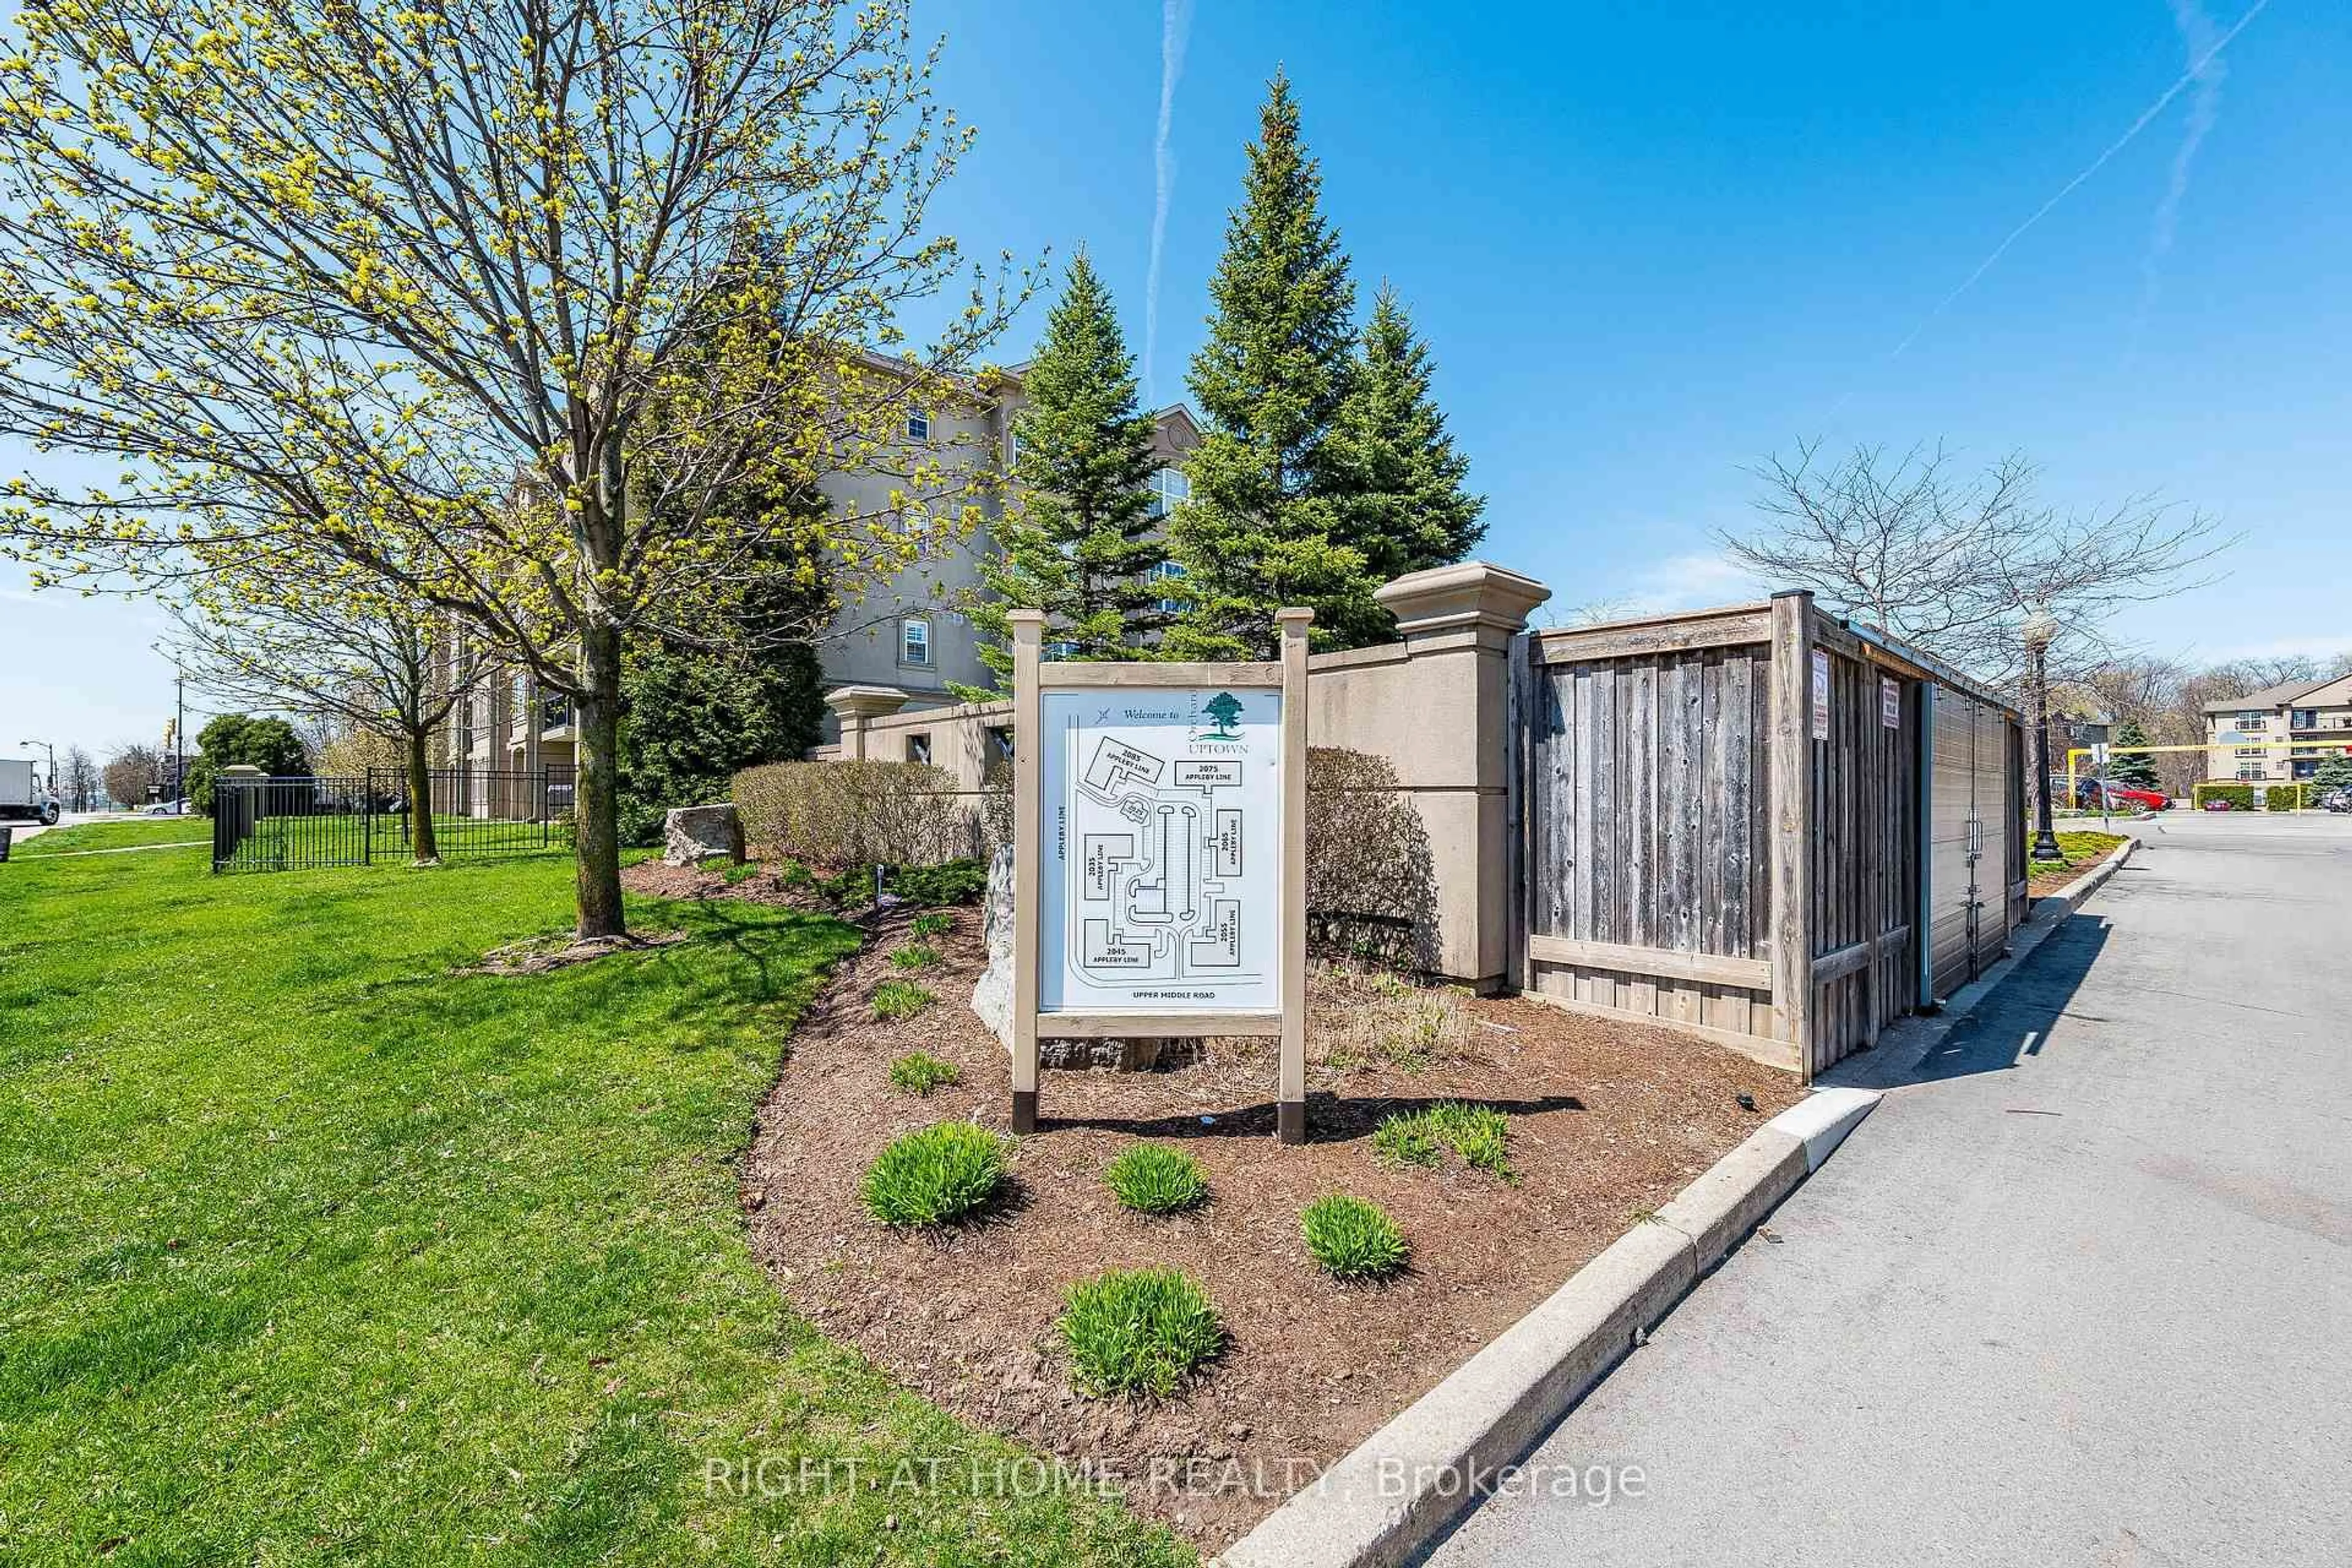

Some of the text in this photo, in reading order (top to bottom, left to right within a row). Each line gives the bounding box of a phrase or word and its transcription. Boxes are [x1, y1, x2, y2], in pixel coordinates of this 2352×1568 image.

[1125, 709, 1179, 720] Welcome to
[1189, 744, 1250, 755] UPTOWN
